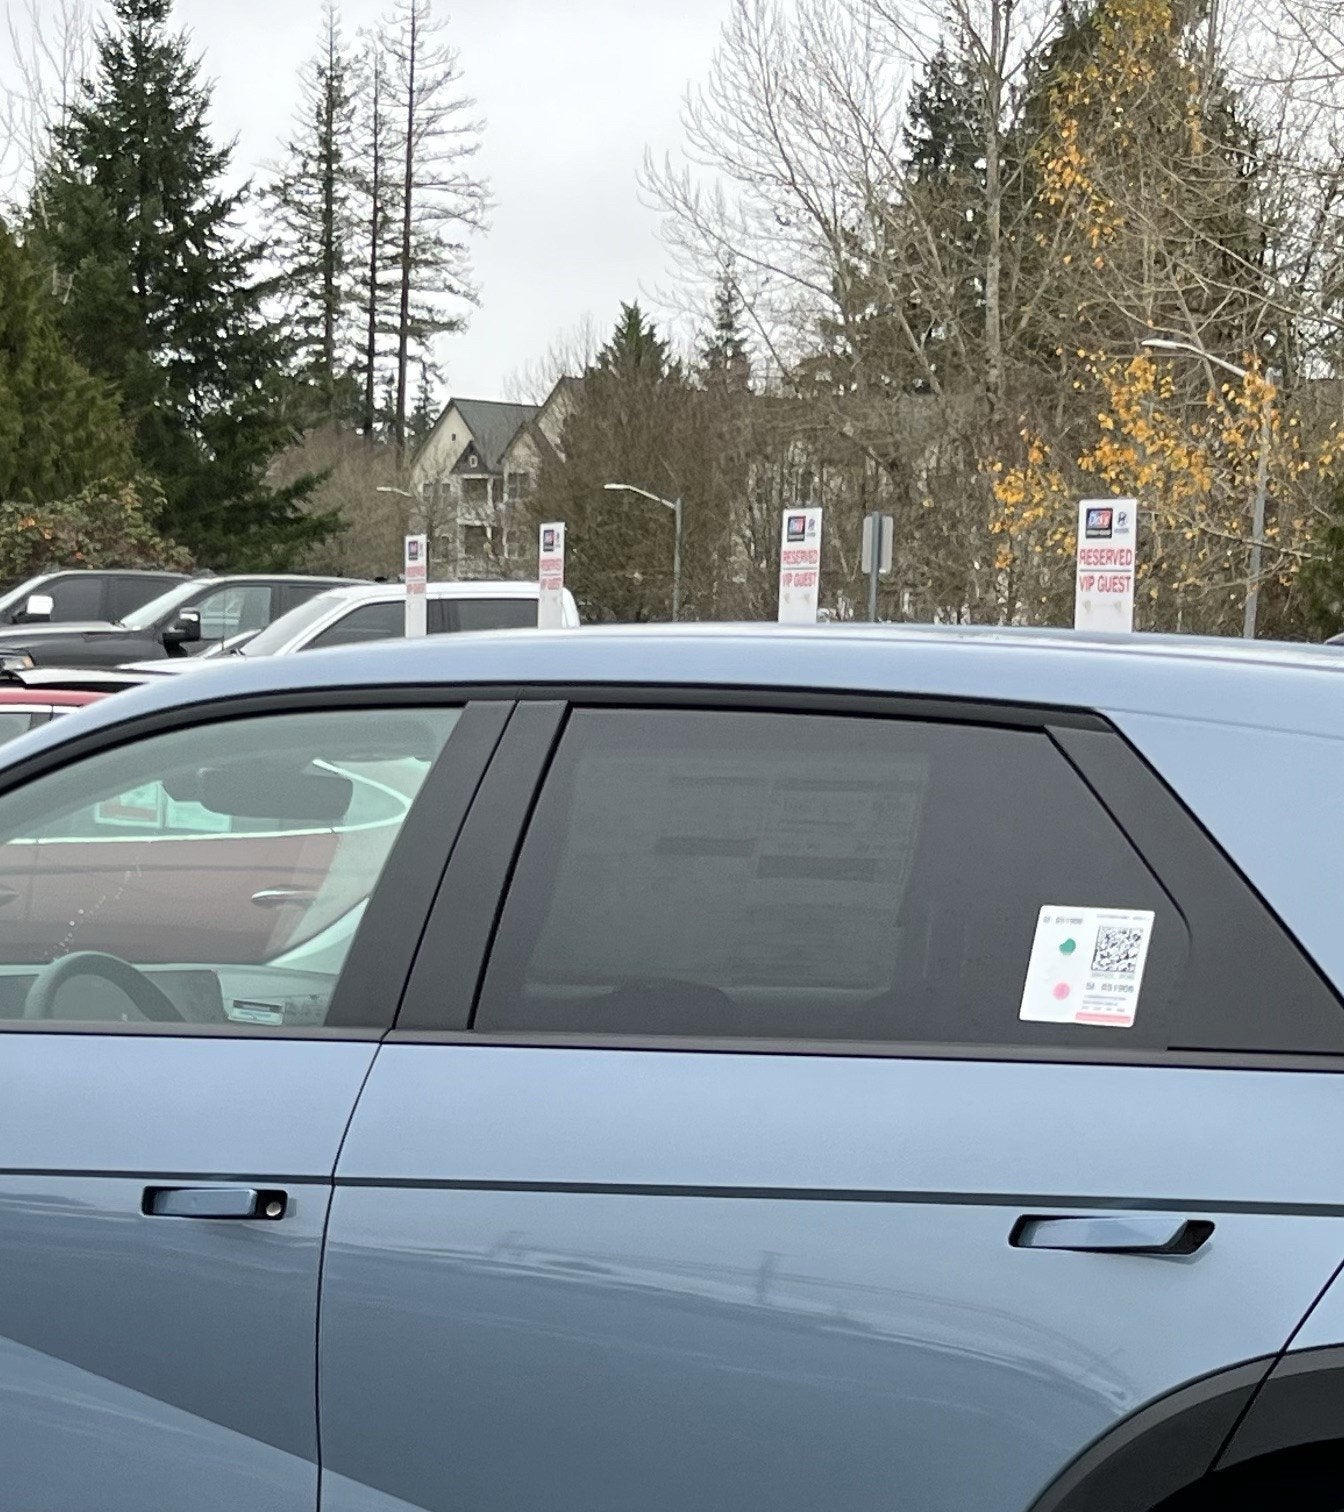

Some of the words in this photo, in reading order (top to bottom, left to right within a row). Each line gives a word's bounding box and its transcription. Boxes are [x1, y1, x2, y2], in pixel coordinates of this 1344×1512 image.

[1078, 548, 1133, 566] RESERVED
[1078, 576, 1095, 592] VIP
[1098, 576, 1131, 593] GUEST
